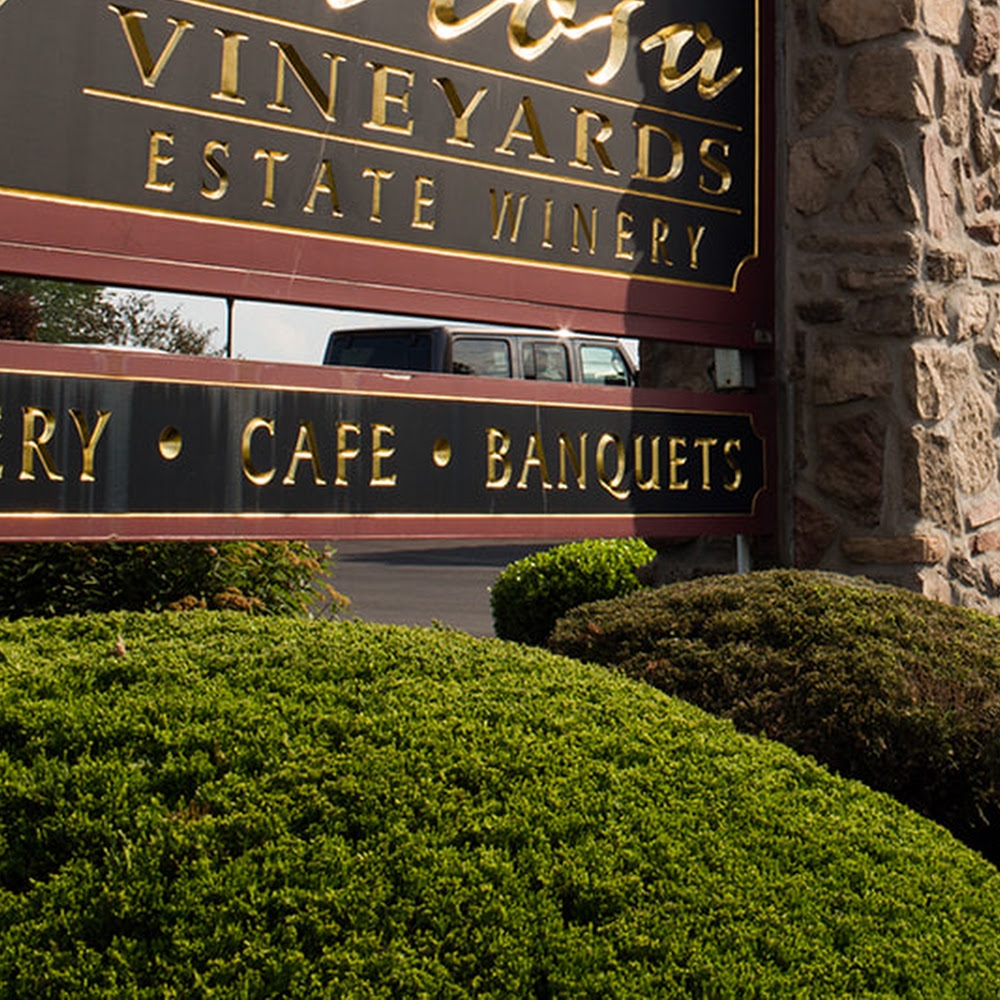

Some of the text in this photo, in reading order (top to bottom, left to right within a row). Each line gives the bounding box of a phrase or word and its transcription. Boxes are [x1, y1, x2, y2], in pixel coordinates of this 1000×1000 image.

[109, 4, 733, 195] VINEYARDS
[144, 130, 707, 271] ESTATE WINERY
[0, 406, 744, 500] RY CAFE BANQUETS
